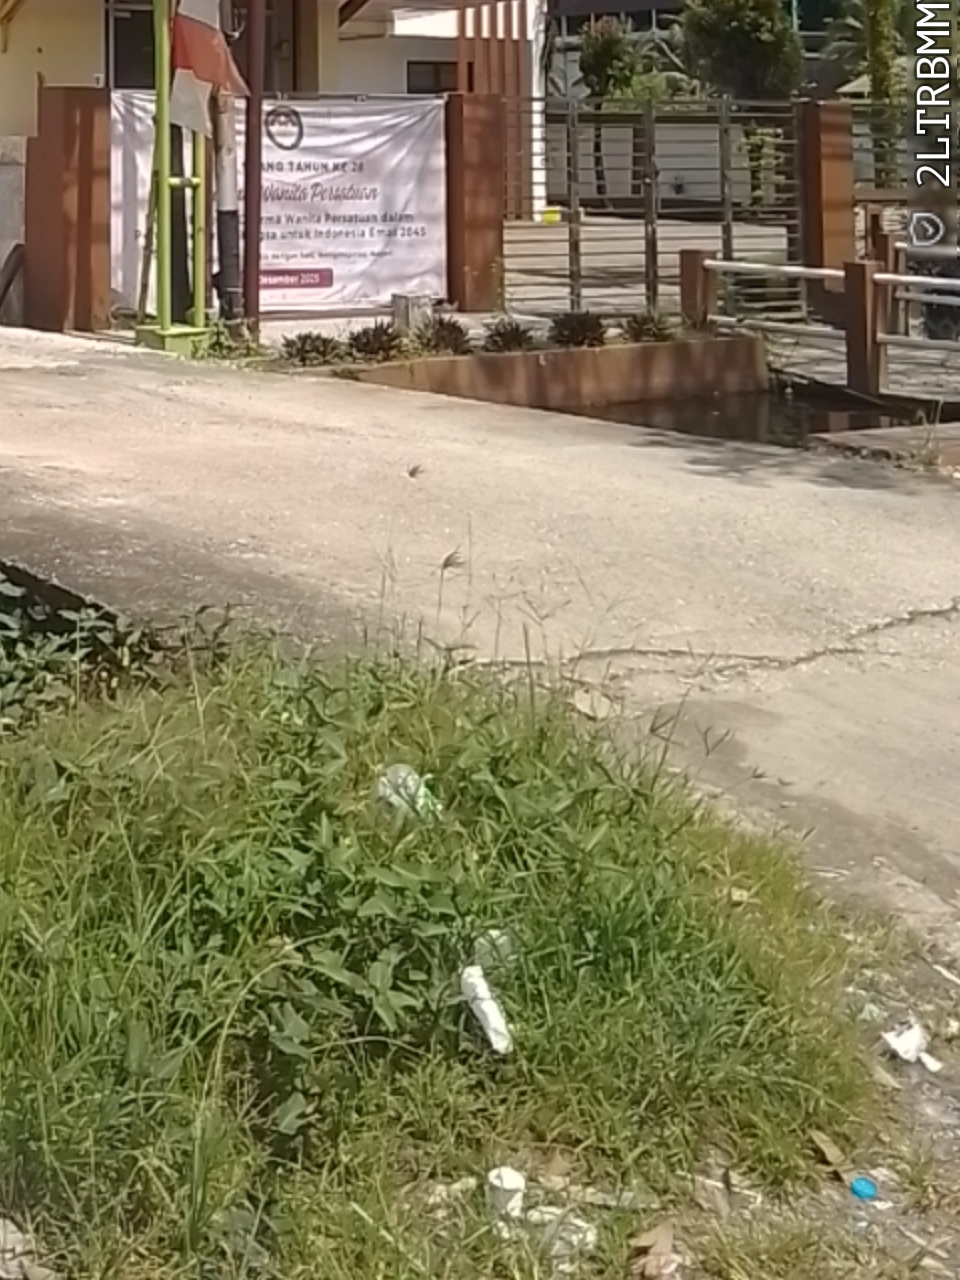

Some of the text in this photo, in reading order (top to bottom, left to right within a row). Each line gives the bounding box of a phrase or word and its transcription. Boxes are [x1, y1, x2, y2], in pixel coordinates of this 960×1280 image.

[288, 161, 328, 172] TAHUN
[284, 213, 321, 225] Wanita
[324, 212, 378, 224] Persatuan
[381, 211, 414, 223] dalam
[281, 229, 311, 241] untuk
[313, 227, 366, 240] Indonesia
[400, 224, 427, 238] 2045
